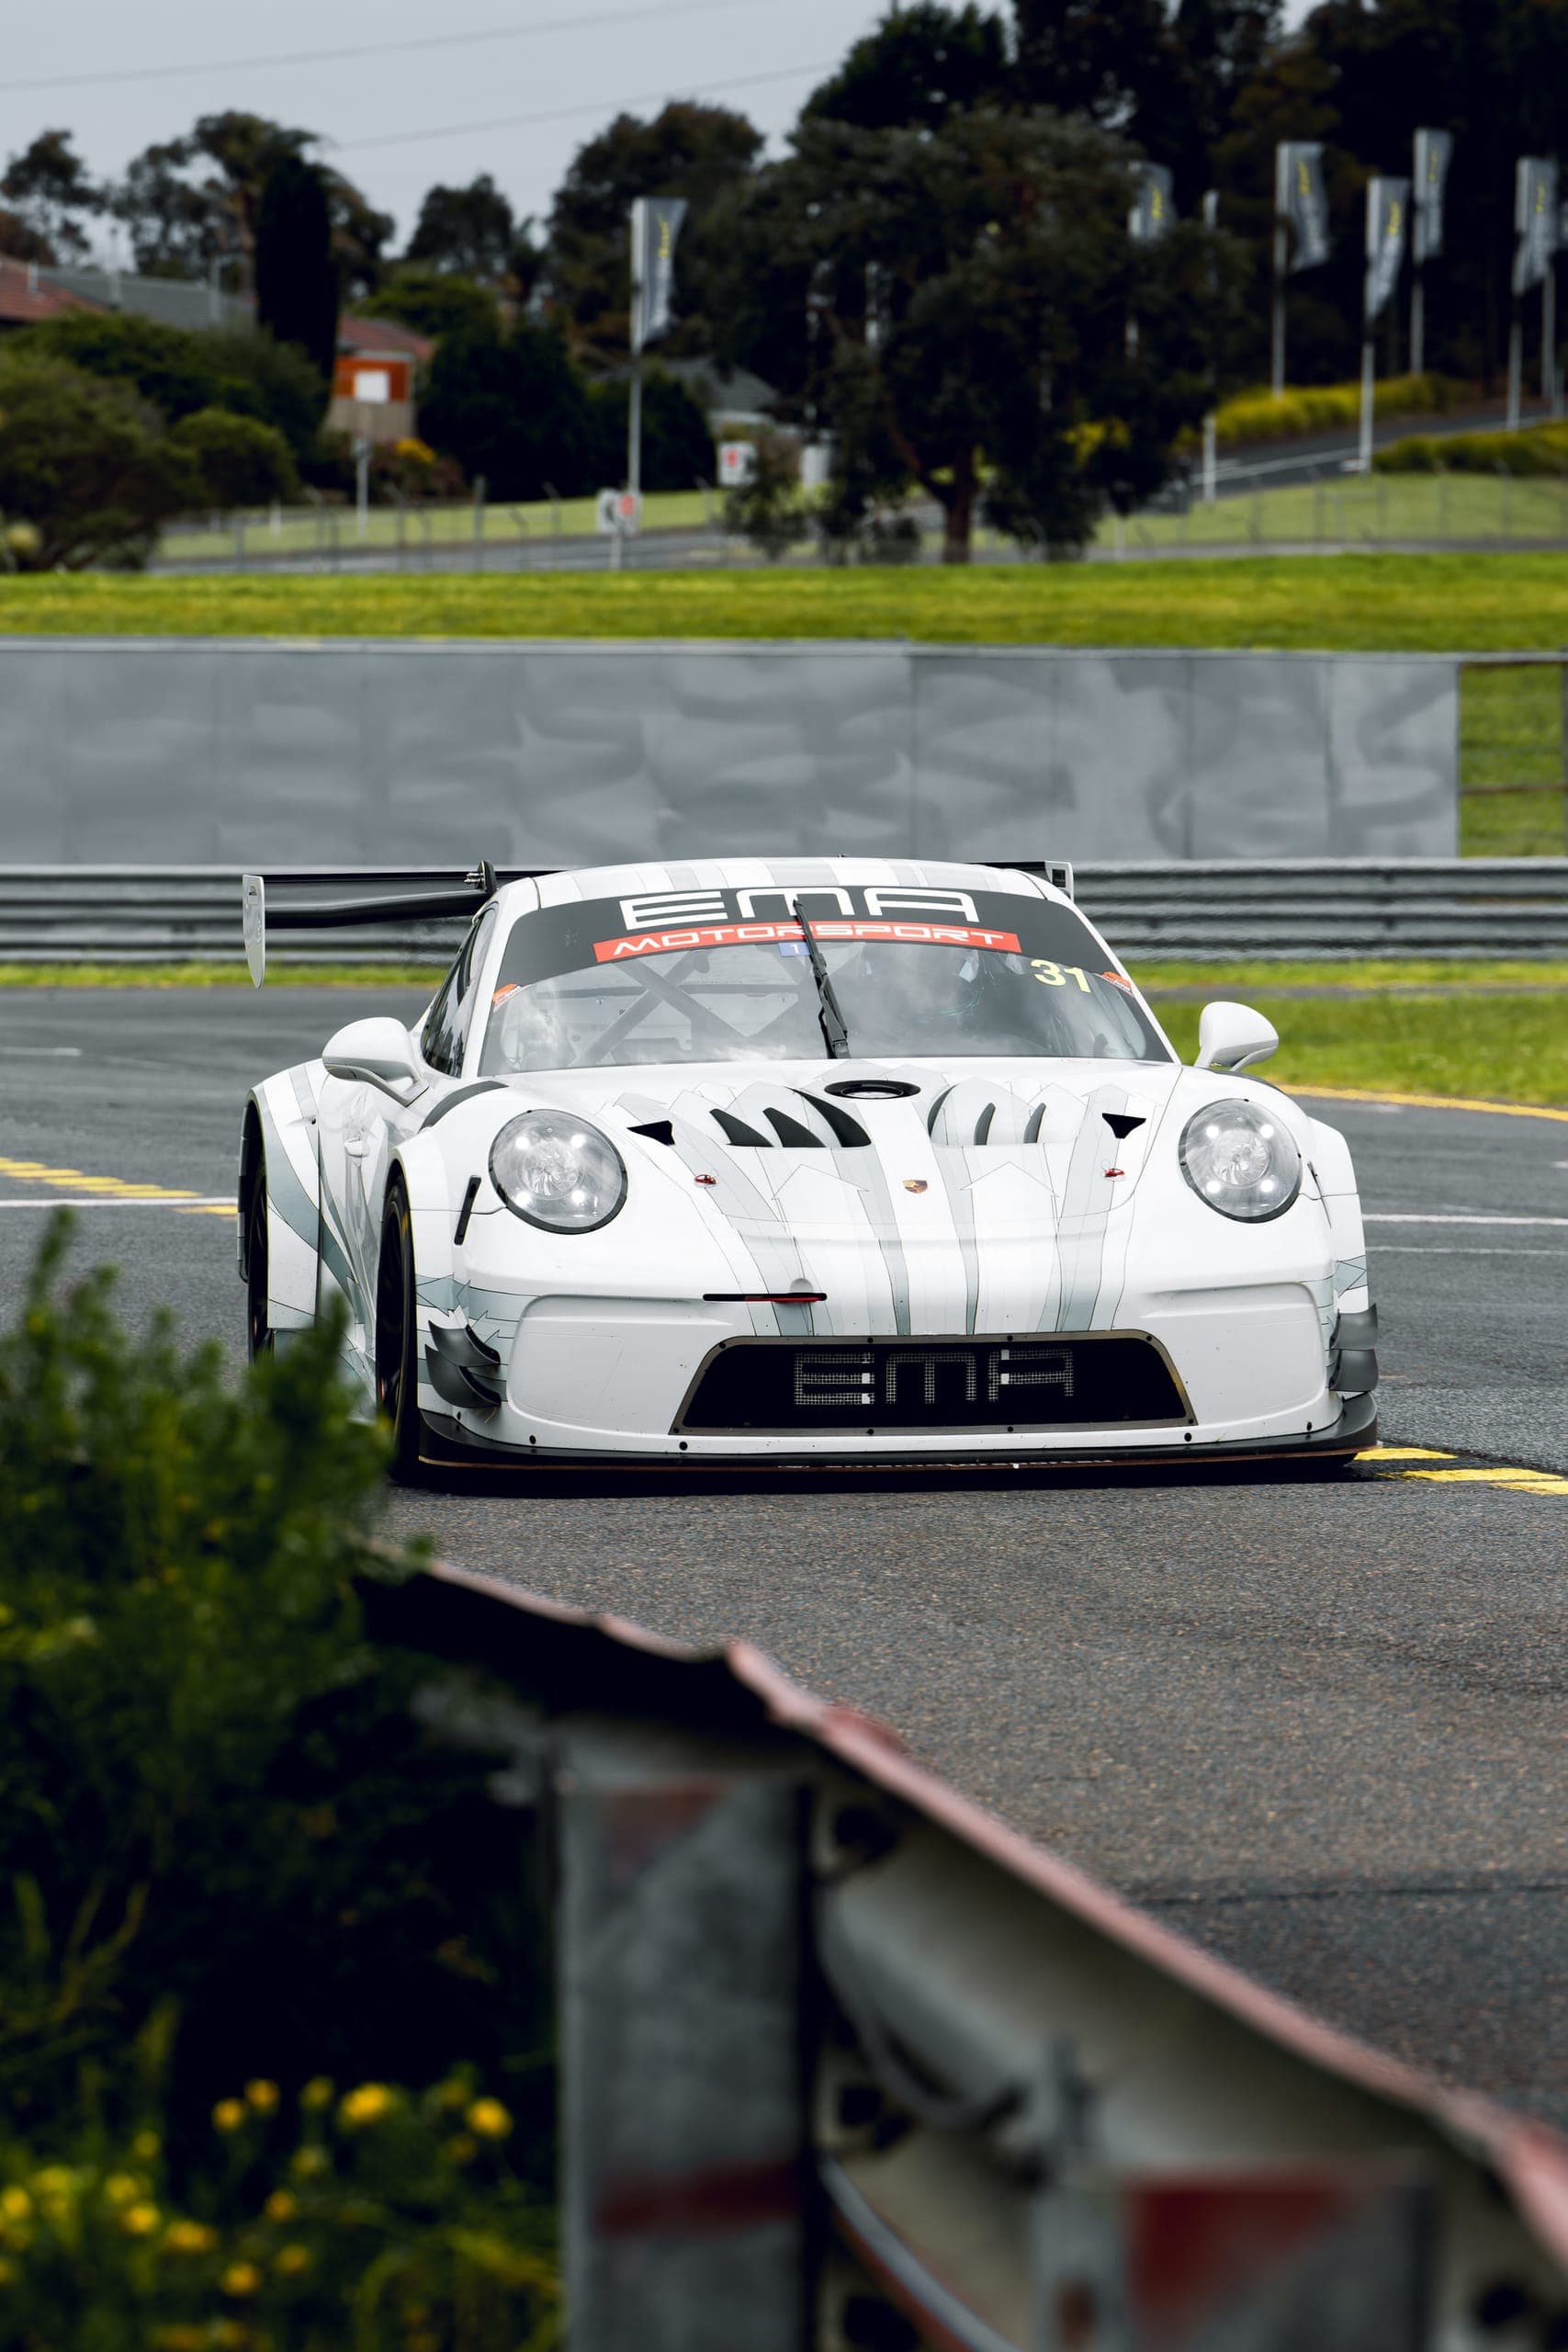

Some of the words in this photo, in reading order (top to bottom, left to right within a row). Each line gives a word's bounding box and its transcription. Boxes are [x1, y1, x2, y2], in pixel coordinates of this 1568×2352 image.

[619, 888, 979, 930] EMA
[613, 924, 1004, 955] MOTORSPORT
[1031, 959, 1091, 992] 31
[794, 1349, 1074, 1406] EMA
